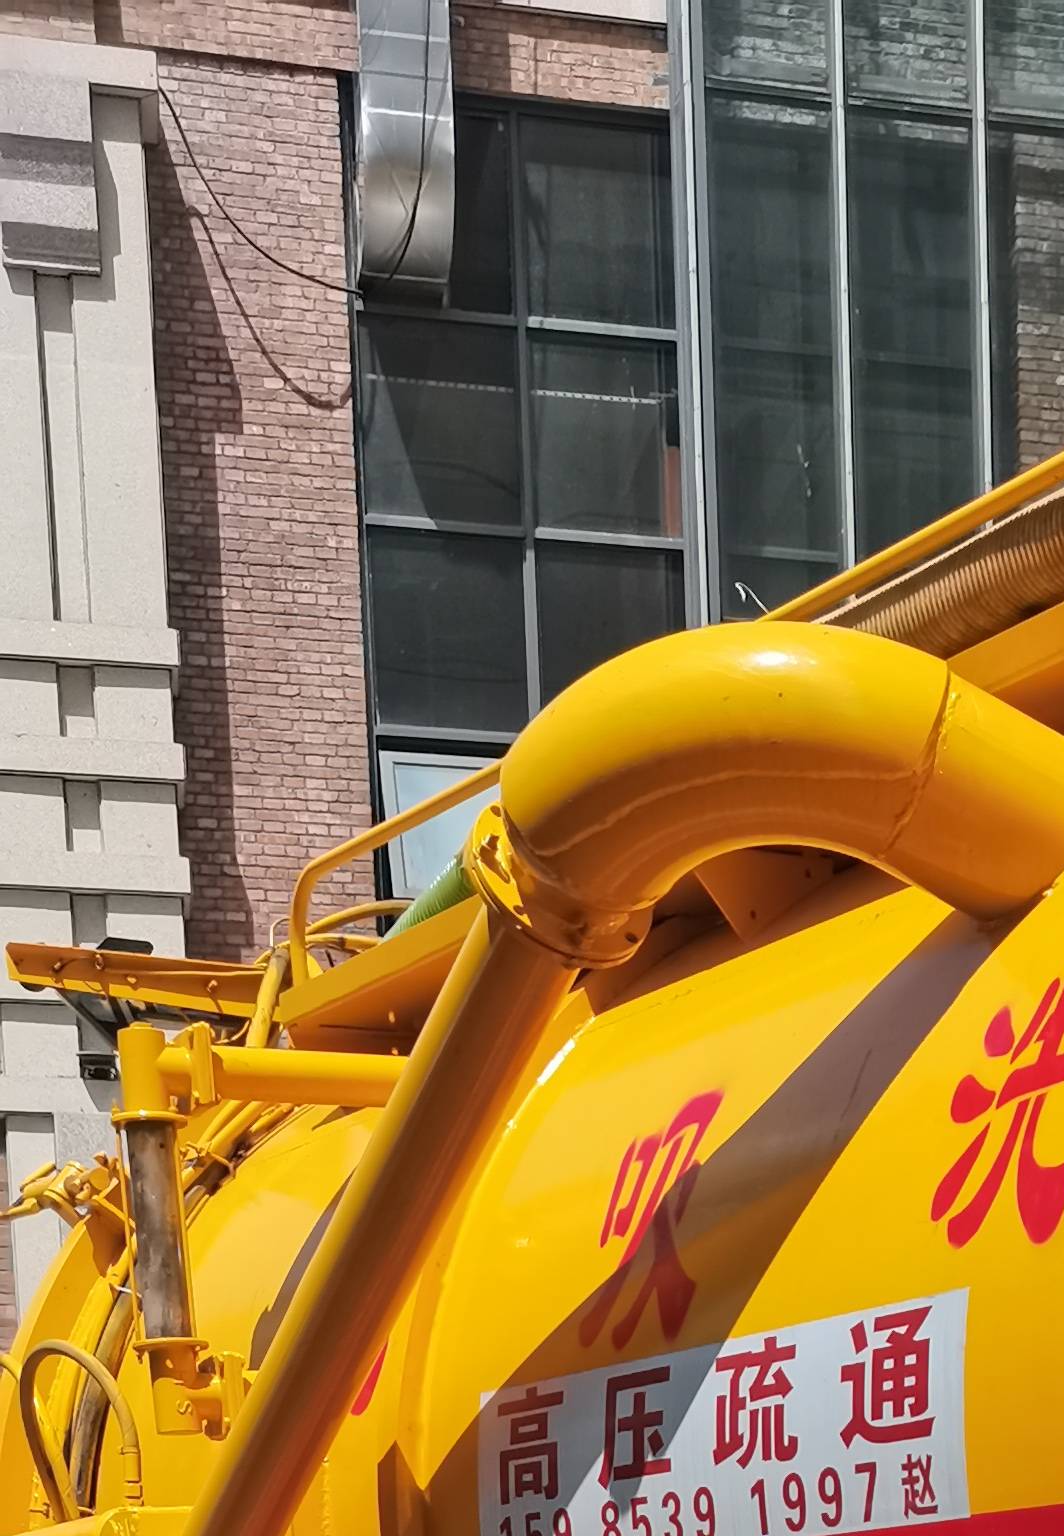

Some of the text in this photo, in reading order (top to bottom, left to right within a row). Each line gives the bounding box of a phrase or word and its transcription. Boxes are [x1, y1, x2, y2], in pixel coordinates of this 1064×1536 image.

[497, 1305, 936, 1505] 高压疏通
[751, 1462, 878, 1536] 1997
[901, 1454, 938, 1518] 赵
